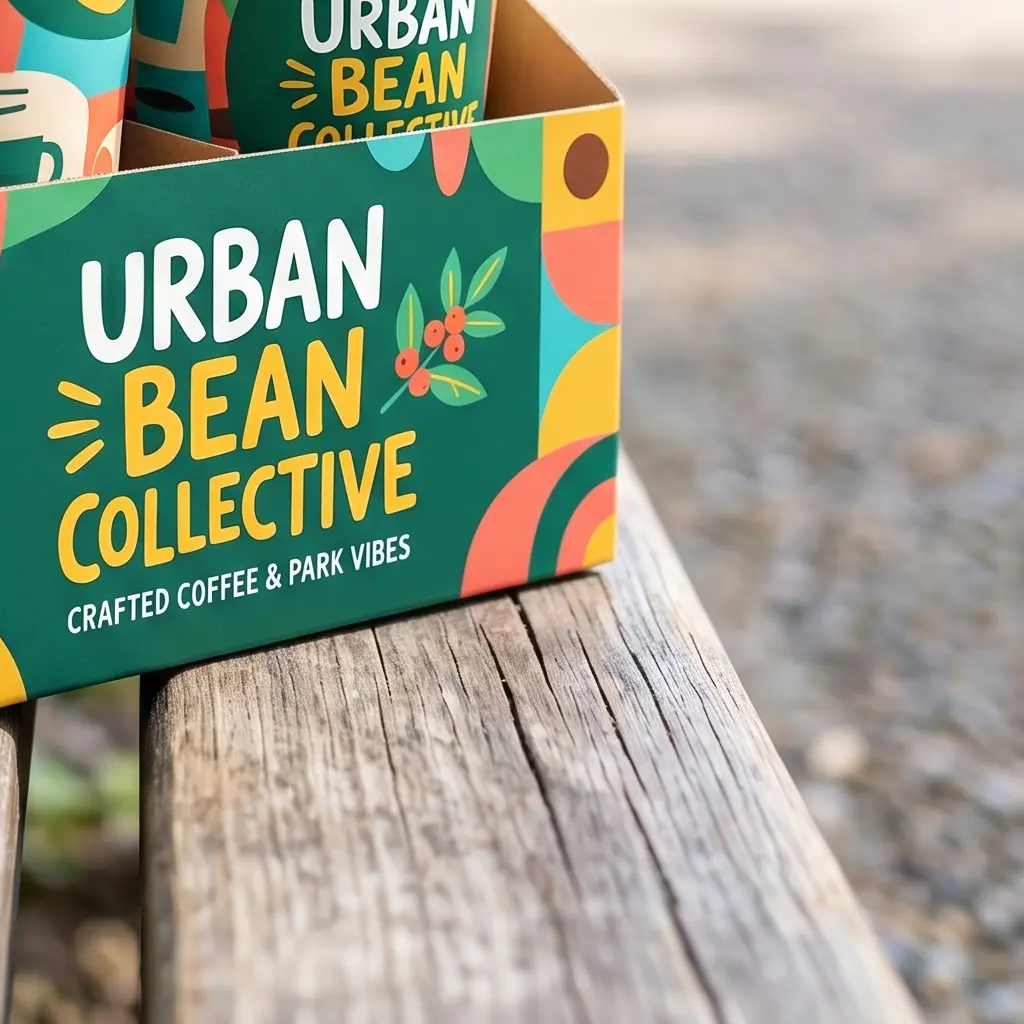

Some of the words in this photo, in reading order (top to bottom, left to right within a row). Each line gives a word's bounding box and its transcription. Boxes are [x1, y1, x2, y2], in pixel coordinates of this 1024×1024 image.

[331, 44, 466, 117] BEAN
[81, 204, 385, 364] URBAN
[124, 326, 365, 478] BEAN
[57, 430, 418, 584] COLLECTIVE
[66, 587, 170, 635] CRAFTED
[176, 566, 259, 610] COFFEE
[265, 563, 282, 591] &
[288, 548, 344, 587] PARK
[350, 533, 412, 572] VIBES
